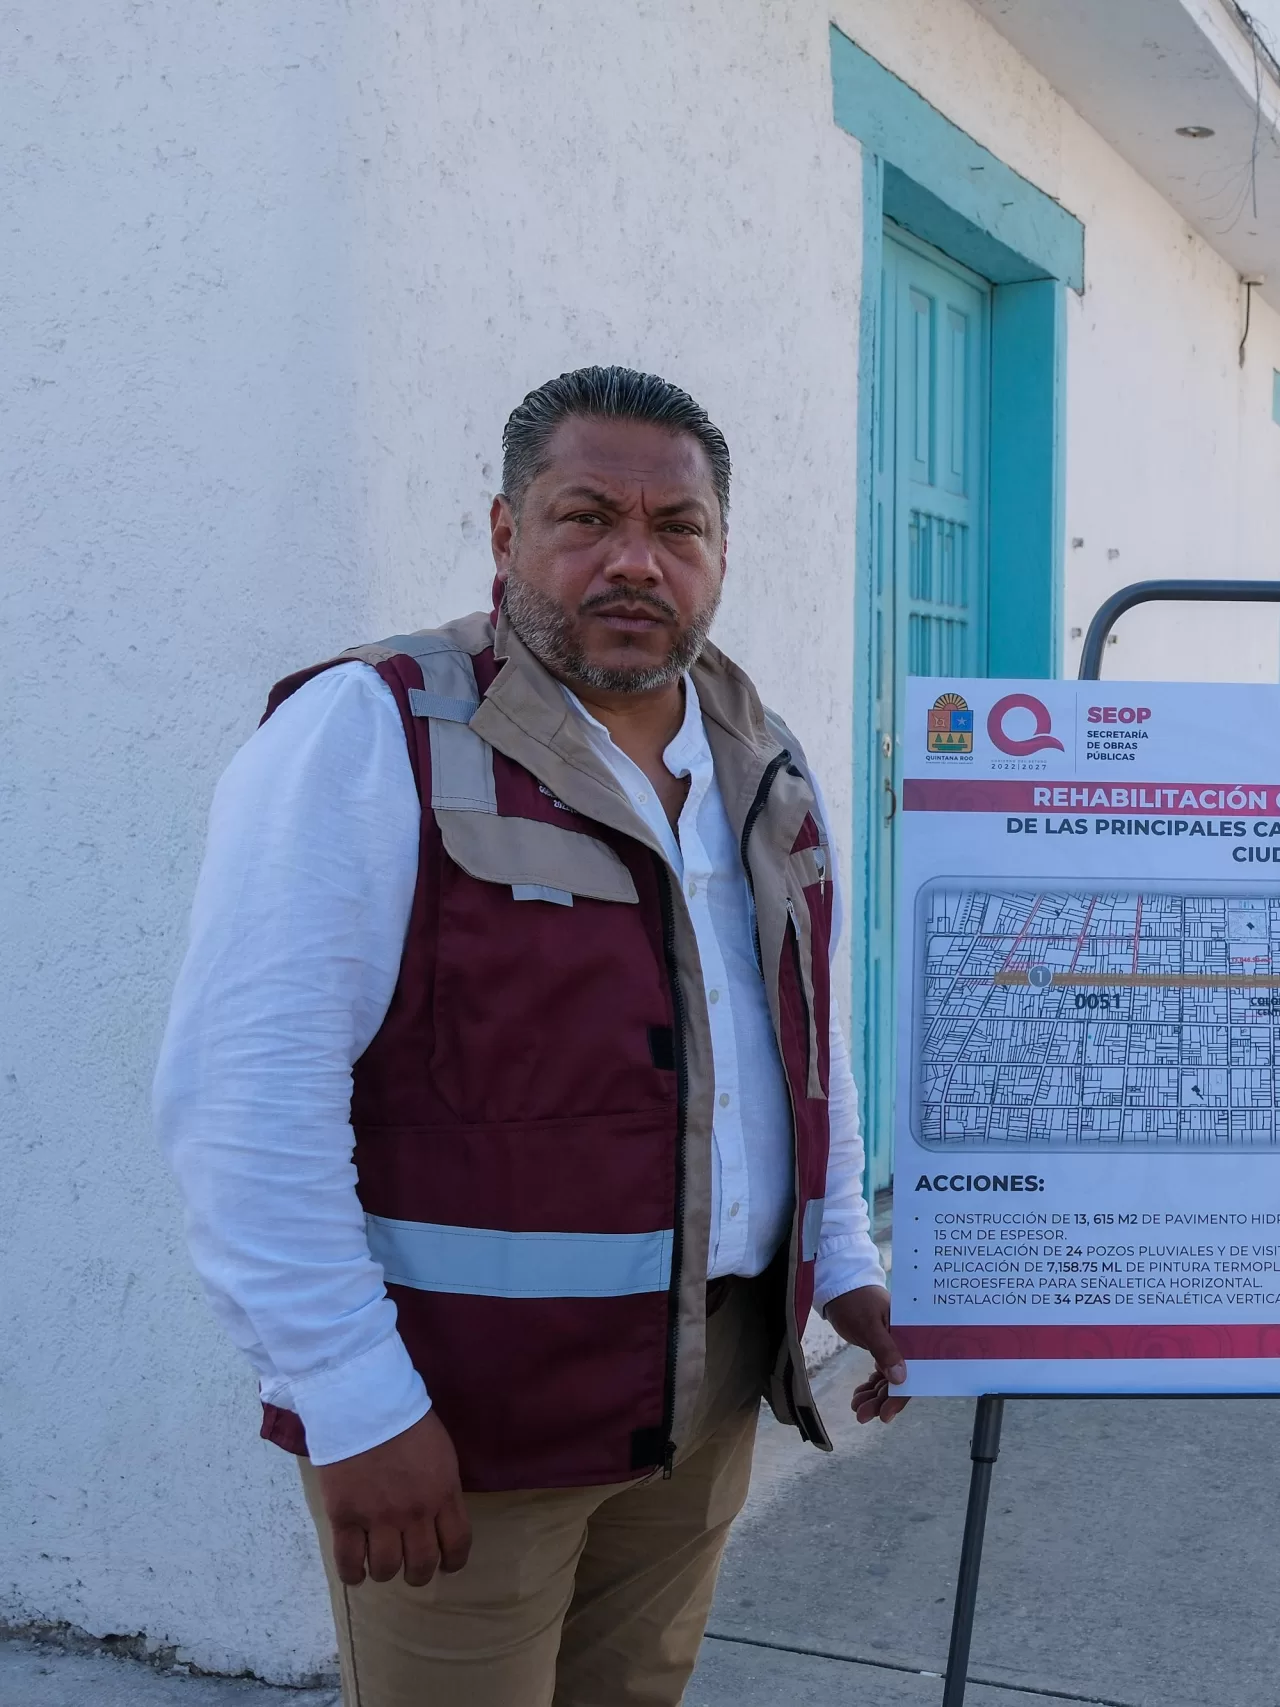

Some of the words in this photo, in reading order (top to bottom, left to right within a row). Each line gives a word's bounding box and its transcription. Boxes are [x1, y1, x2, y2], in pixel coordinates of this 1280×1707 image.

[1087, 707, 1151, 723] SEOP
[1087, 730, 1148, 739] SECRETARÍA
[1087, 742, 1100, 750] DE
[1103, 742, 1138, 750] OBRAS
[1087, 751, 1135, 761] PÚBLICAS
[1033, 785, 1267, 810] REHABILITACIÓN
[1007, 818, 1037, 833] DE
[1045, 818, 1088, 835] LAS
[1096, 819, 1246, 837] PRINCIPALES
[1074, 994, 1120, 1010] 0051
[915, 1175, 1044, 1192] ACCIONES:
[934, 1212, 1047, 1225] CONSTRUCCIÓN
[1051, 1214, 1070, 1224] DE
[1074, 1214, 1090, 1227] 13,
[1094, 1214, 1114, 1224] 615
[1118, 1214, 1138, 1224] M2
[1142, 1214, 1160, 1224] DE
[1165, 1214, 1247, 1224] PAVIMENTO
[934, 1230, 946, 1240] 15
[950, 1230, 972, 1240] CM
[977, 1230, 995, 1240] DE
[1000, 1230, 1067, 1240] ESPESOR.
[934, 1244, 1039, 1256] RENIVELACIÓN
[1044, 1246, 1062, 1256] DE
[1066, 1246, 1082, 1256] 24
[1086, 1246, 1134, 1256] POZOS
[1139, 1246, 1212, 1256] PLUVIALES
[1217, 1246, 1225, 1256] Y
[1230, 1246, 1248, 1256] DE
[934, 1260, 1020, 1272] APLICACIÓN
[1024, 1262, 1042, 1272] DE
[1047, 1262, 1098, 1275] 7,158.75
[1102, 1262, 1122, 1272] ML
[1126, 1262, 1144, 1272] DE
[1150, 1262, 1210, 1272] PINTURA
[934, 1278, 1034, 1289] MICROESFERA
[1039, 1278, 1077, 1289] PARA
[1081, 1275, 1165, 1289] SEÑALETICA
[1170, 1278, 1262, 1289] HORIZONTAL.
[934, 1292, 1027, 1305] INSTALACIÓN
[1031, 1294, 1050, 1305] DE
[1054, 1294, 1071, 1305] 34
[1075, 1294, 1111, 1305] PZAS
[1115, 1294, 1133, 1305] DE
[1138, 1291, 1222, 1305] SEÑALÉTICA
